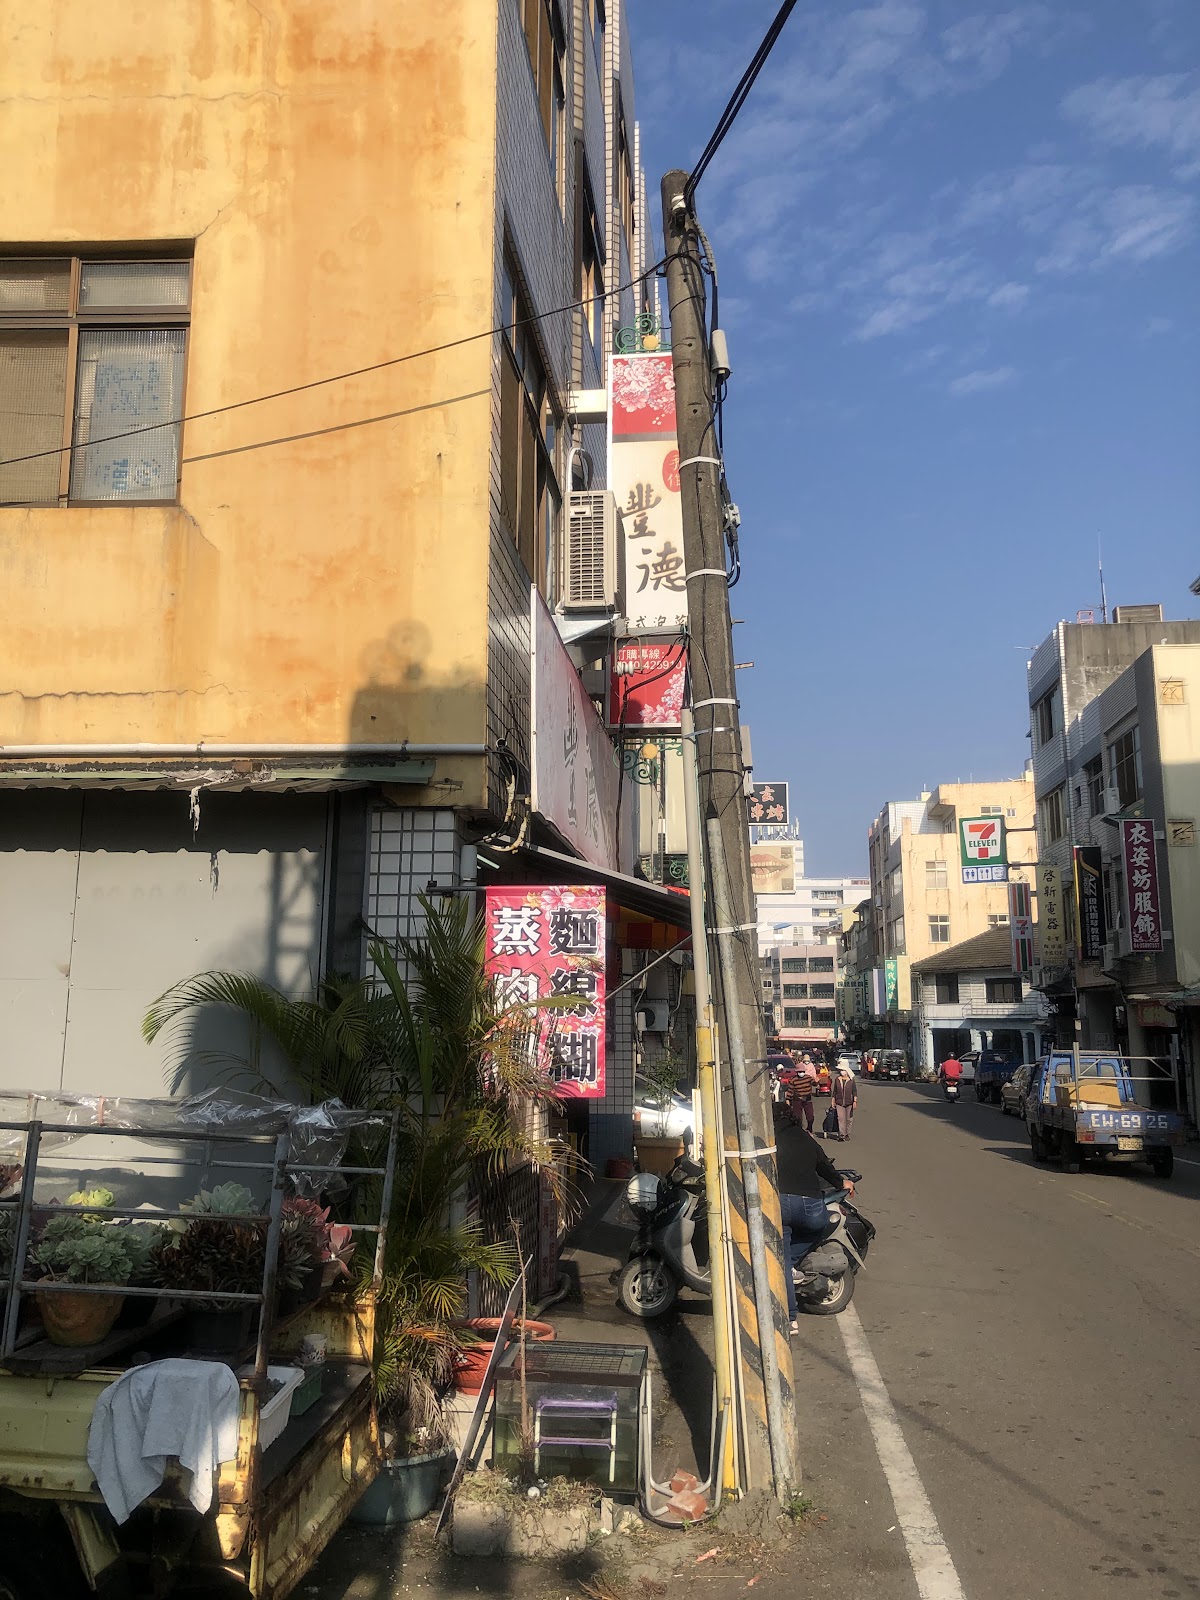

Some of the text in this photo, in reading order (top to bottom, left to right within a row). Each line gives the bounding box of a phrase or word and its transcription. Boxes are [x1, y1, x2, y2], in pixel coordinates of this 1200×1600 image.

[617, 483, 687, 593] 豐德
[1128, 823, 1157, 938] 衣姿坊服飾
